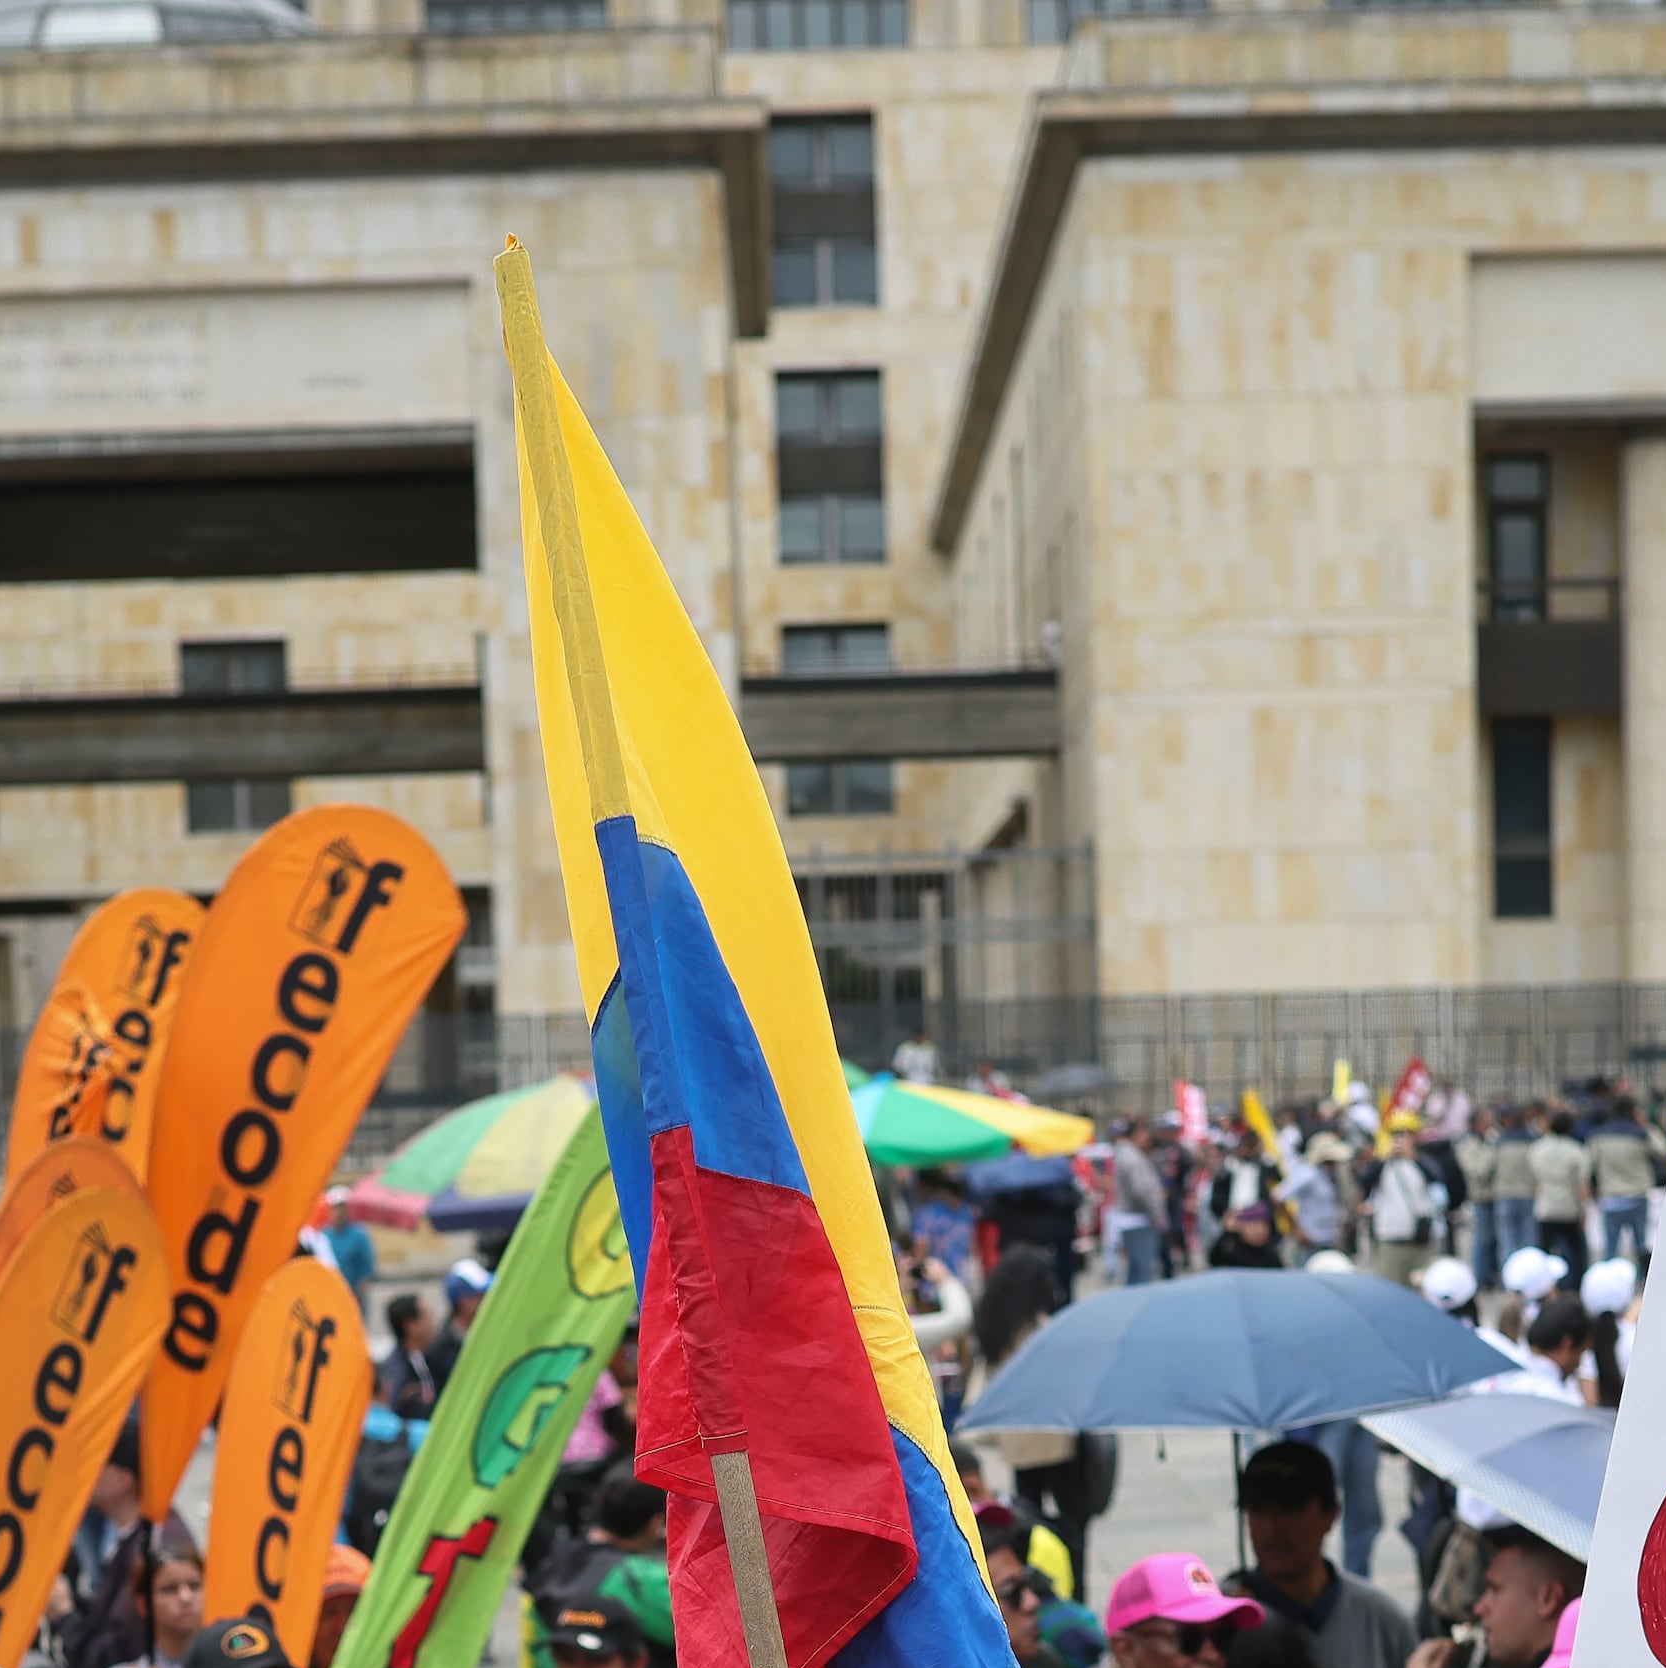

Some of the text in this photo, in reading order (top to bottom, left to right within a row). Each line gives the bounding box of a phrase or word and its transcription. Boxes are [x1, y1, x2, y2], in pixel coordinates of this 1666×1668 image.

[102, 931, 189, 1142] fec
[163, 861, 405, 1374] fecode
[247, 1318, 336, 1622] fec
